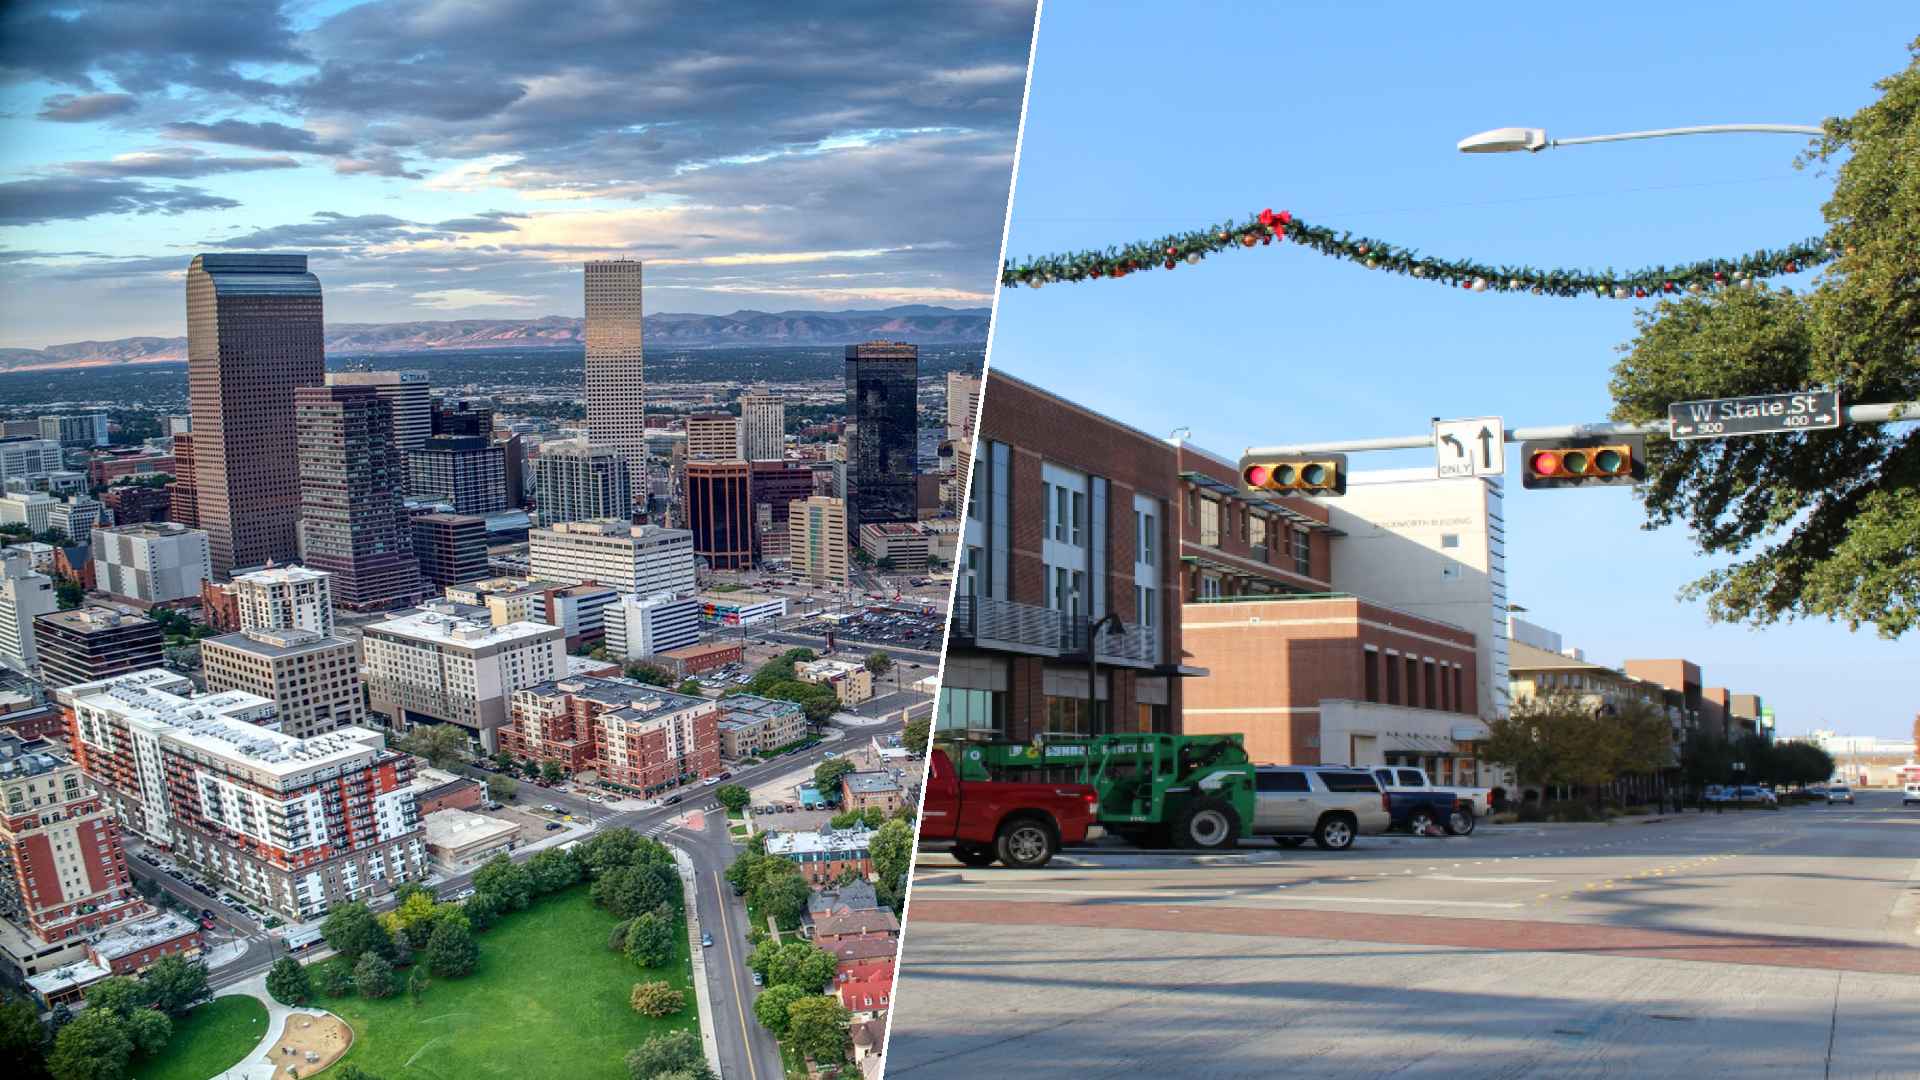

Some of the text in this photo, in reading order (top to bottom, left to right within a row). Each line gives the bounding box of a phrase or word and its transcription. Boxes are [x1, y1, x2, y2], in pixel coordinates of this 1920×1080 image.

[1689, 395, 1817, 422] W State St
[1783, 415, 1810, 426] 400
[1697, 422, 1724, 433] 500
[1440, 464, 1471, 474] ONLY
